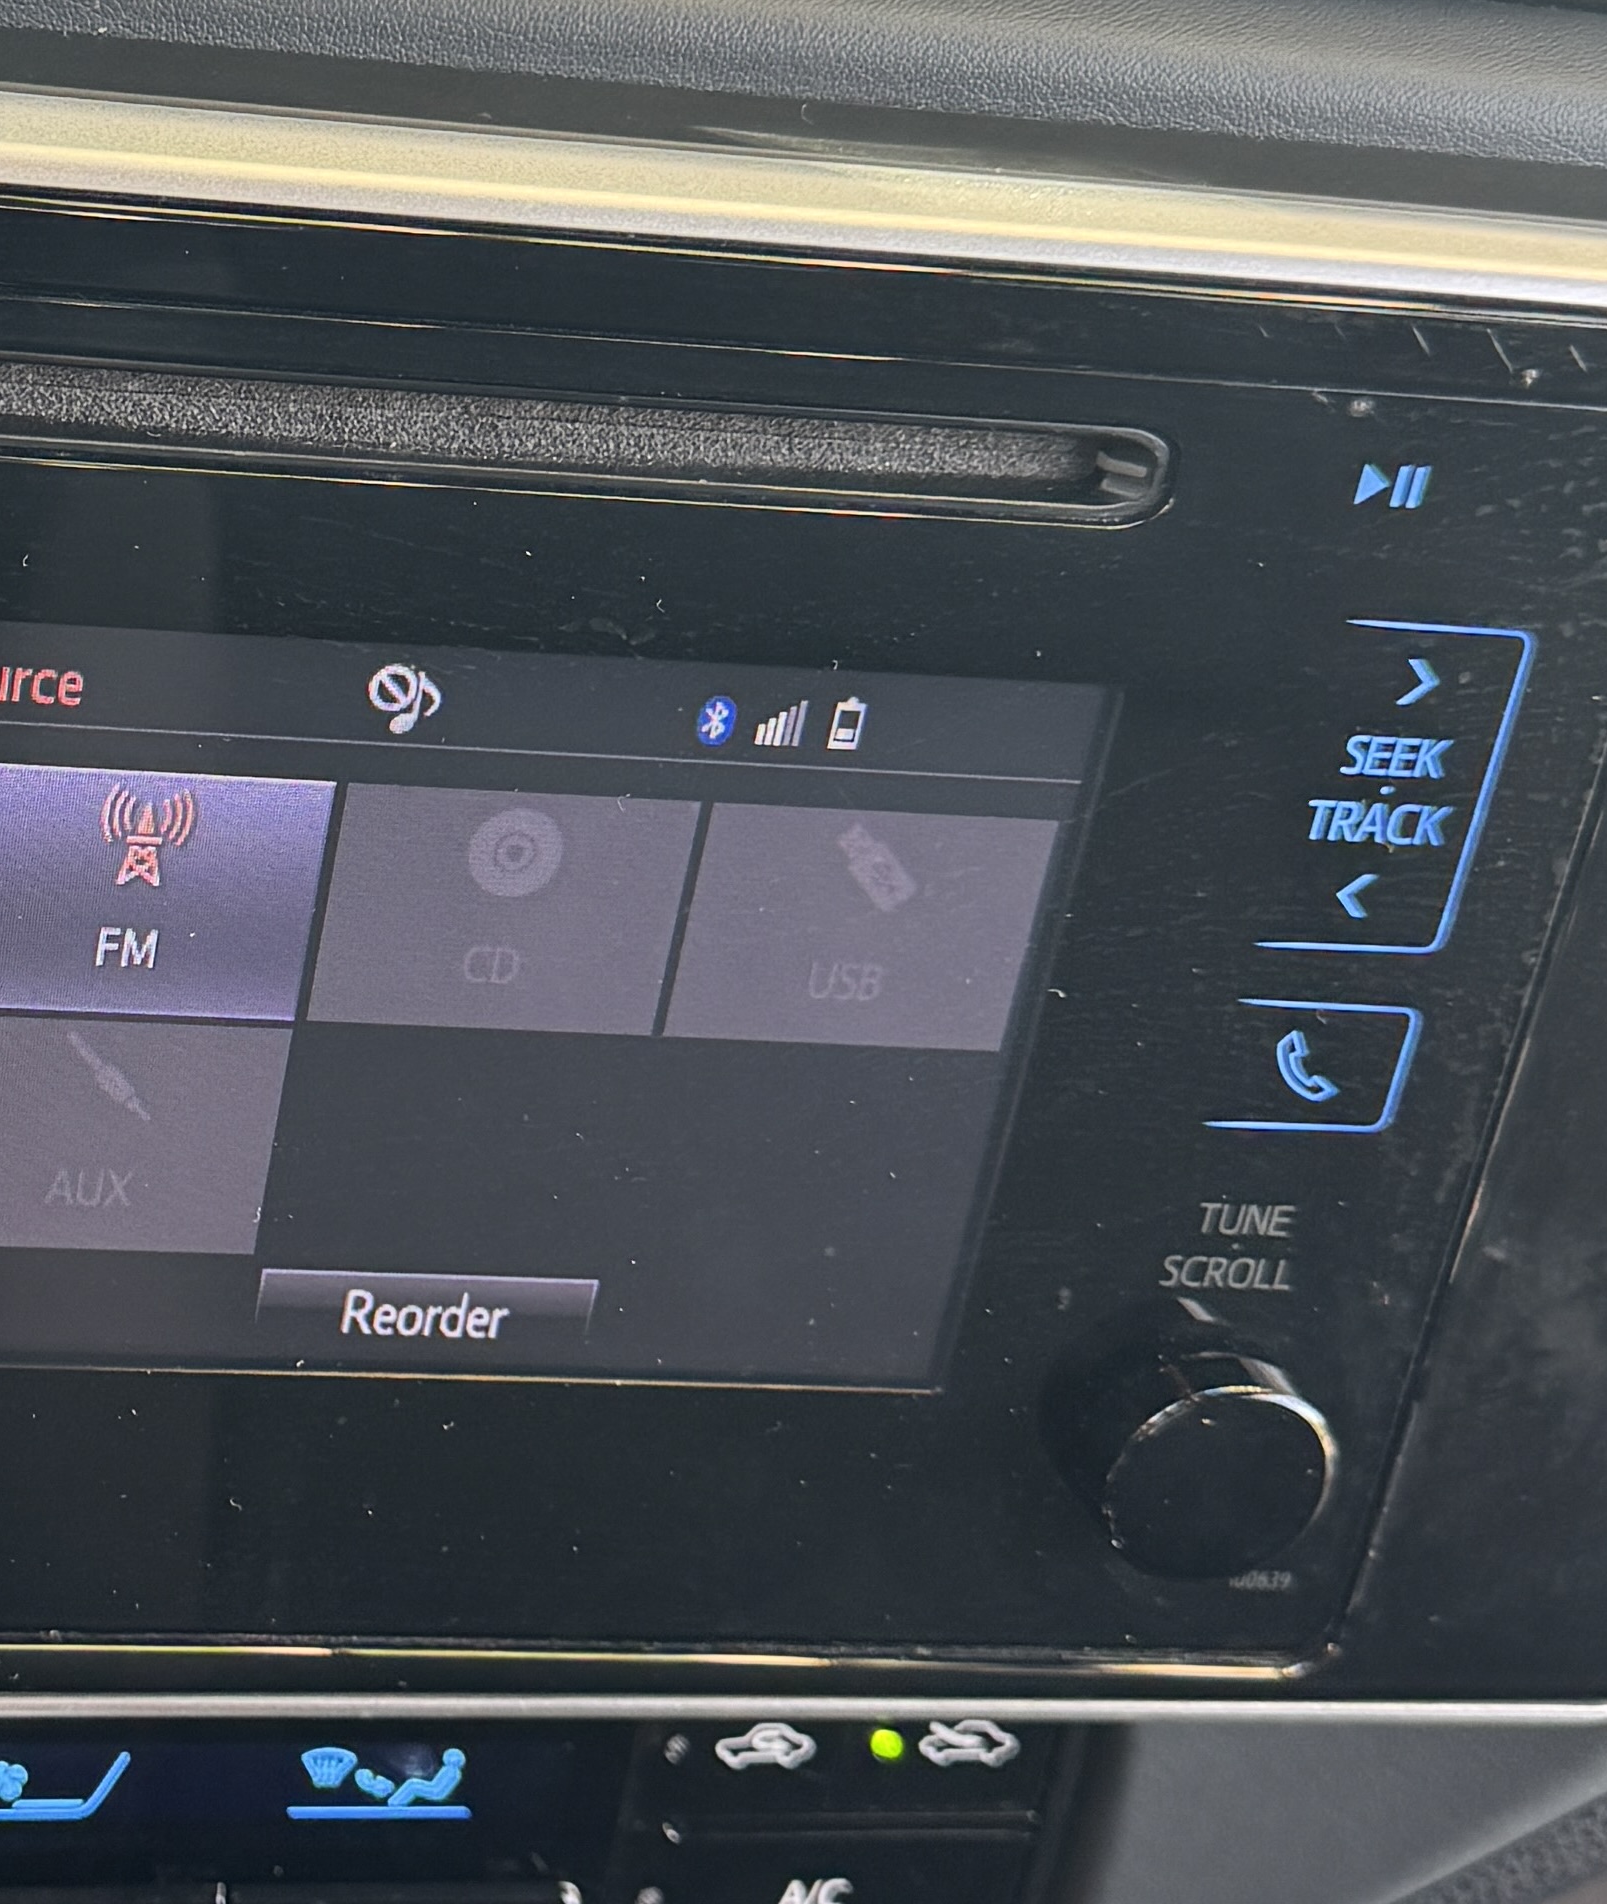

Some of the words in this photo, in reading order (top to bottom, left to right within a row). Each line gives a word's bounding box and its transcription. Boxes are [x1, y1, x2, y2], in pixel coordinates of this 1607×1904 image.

[1339, 734, 1454, 779] SEEK
[1308, 799, 1453, 847] TRACK
[95, 927, 159, 969] FM
[463, 945, 520, 984] CD
[809, 962, 884, 1001] USB
[45, 1168, 134, 1207] AUX
[1200, 1202, 1296, 1237] TUNE
[1159, 1254, 1291, 1291] SCROLL
[341, 1288, 510, 1339] Reorder
